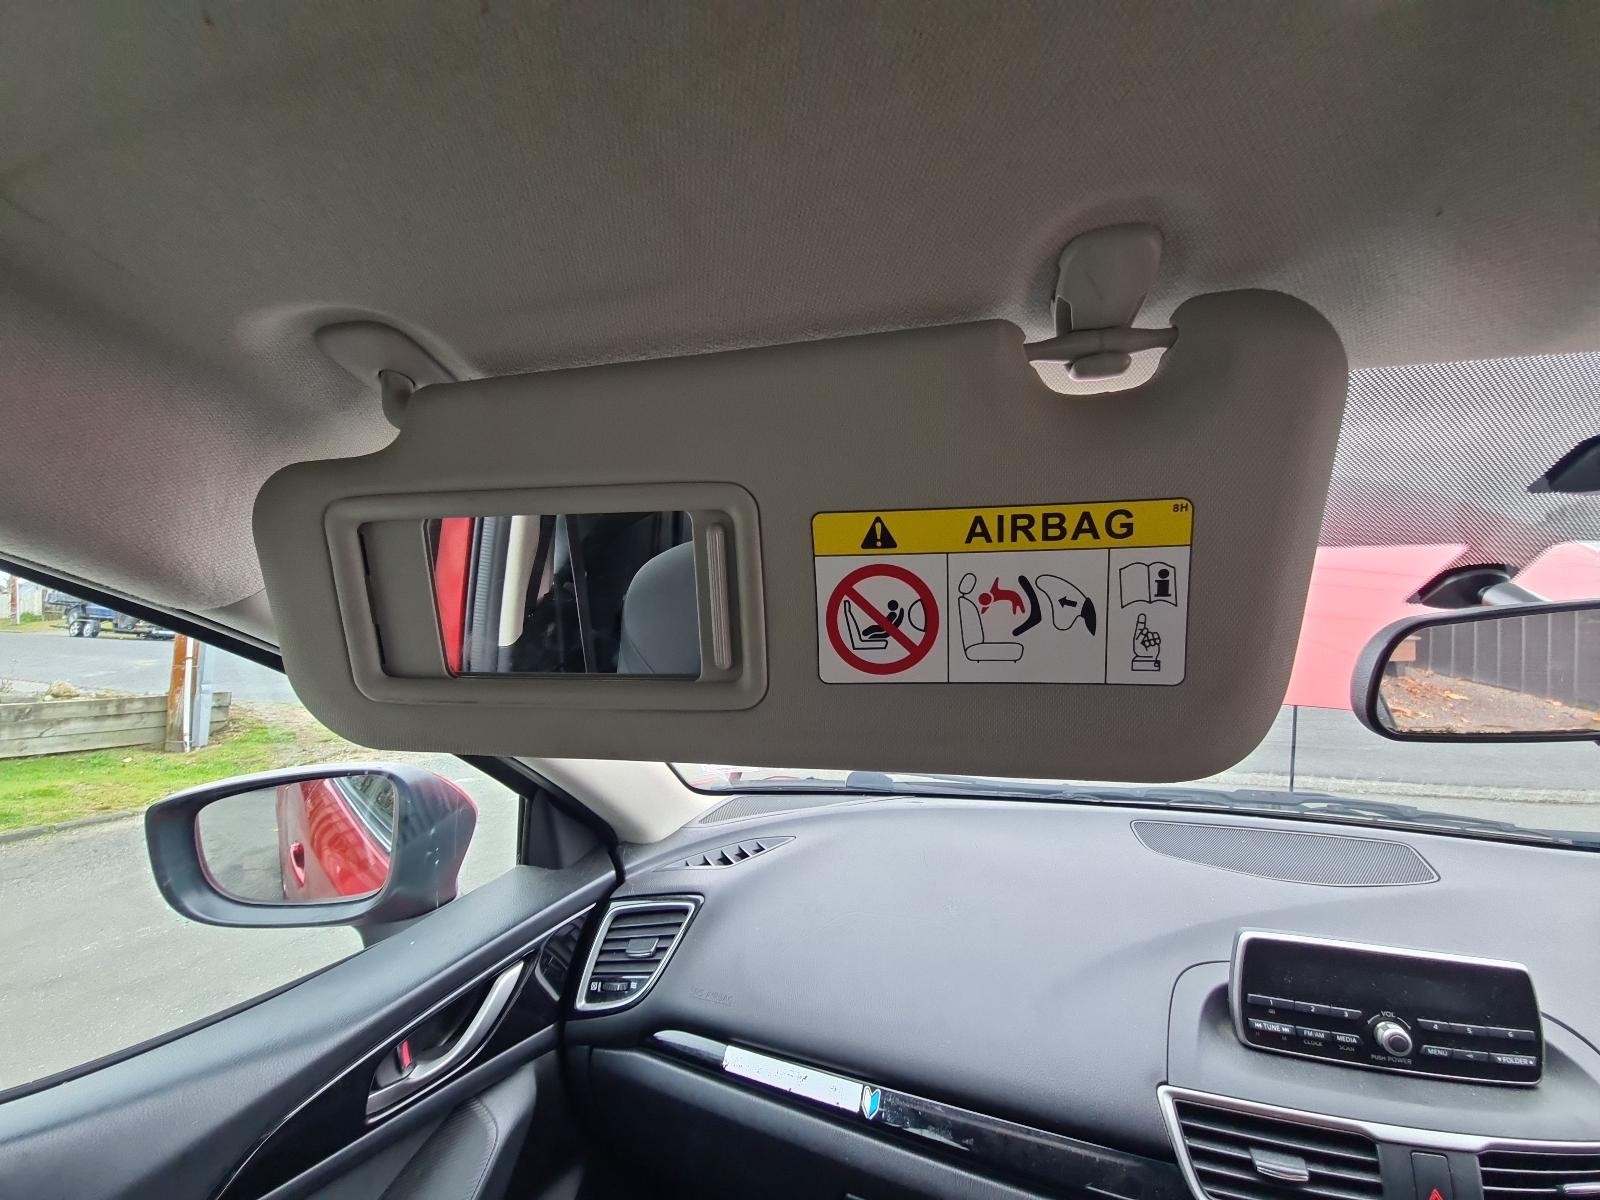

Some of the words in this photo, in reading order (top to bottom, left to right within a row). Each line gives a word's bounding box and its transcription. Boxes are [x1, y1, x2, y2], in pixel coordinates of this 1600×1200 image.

[964, 508, 1135, 544] AIRBAG
[1381, 1010, 1396, 1018] VOL
[1264, 1024, 1281, 1032] TUNE
[1303, 1030, 1325, 1038] FM/AM
[1336, 1035, 1357, 1043] MEDIA
[1427, 1048, 1448, 1057] MENU
[1388, 1056, 1412, 1064] POWER
[1502, 1056, 1529, 1065] FOLDER
